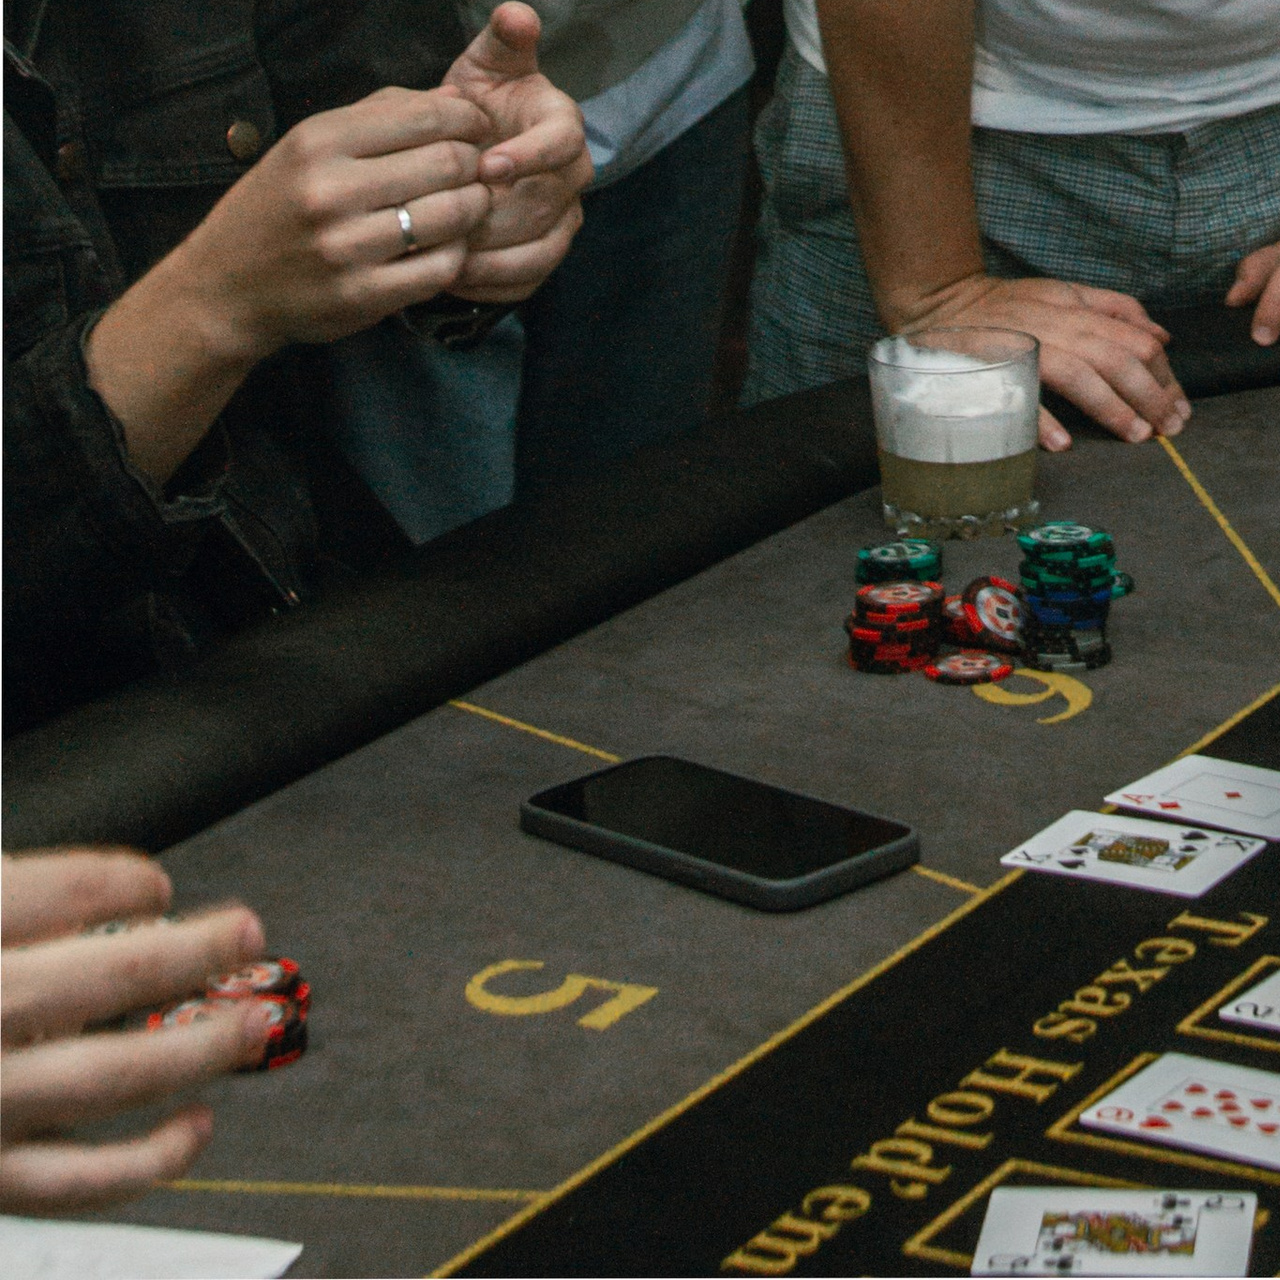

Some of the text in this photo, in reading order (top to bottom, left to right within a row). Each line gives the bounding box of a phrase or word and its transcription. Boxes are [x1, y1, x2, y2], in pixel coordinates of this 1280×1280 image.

[1121, 791, 1155, 805] A
[1215, 836, 1256, 853] K
[1013, 850, 1052, 864] K
[1031, 908, 1271, 1044] Texas
[464, 958, 660, 1032] 5
[1234, 1001, 1274, 1019] 2
